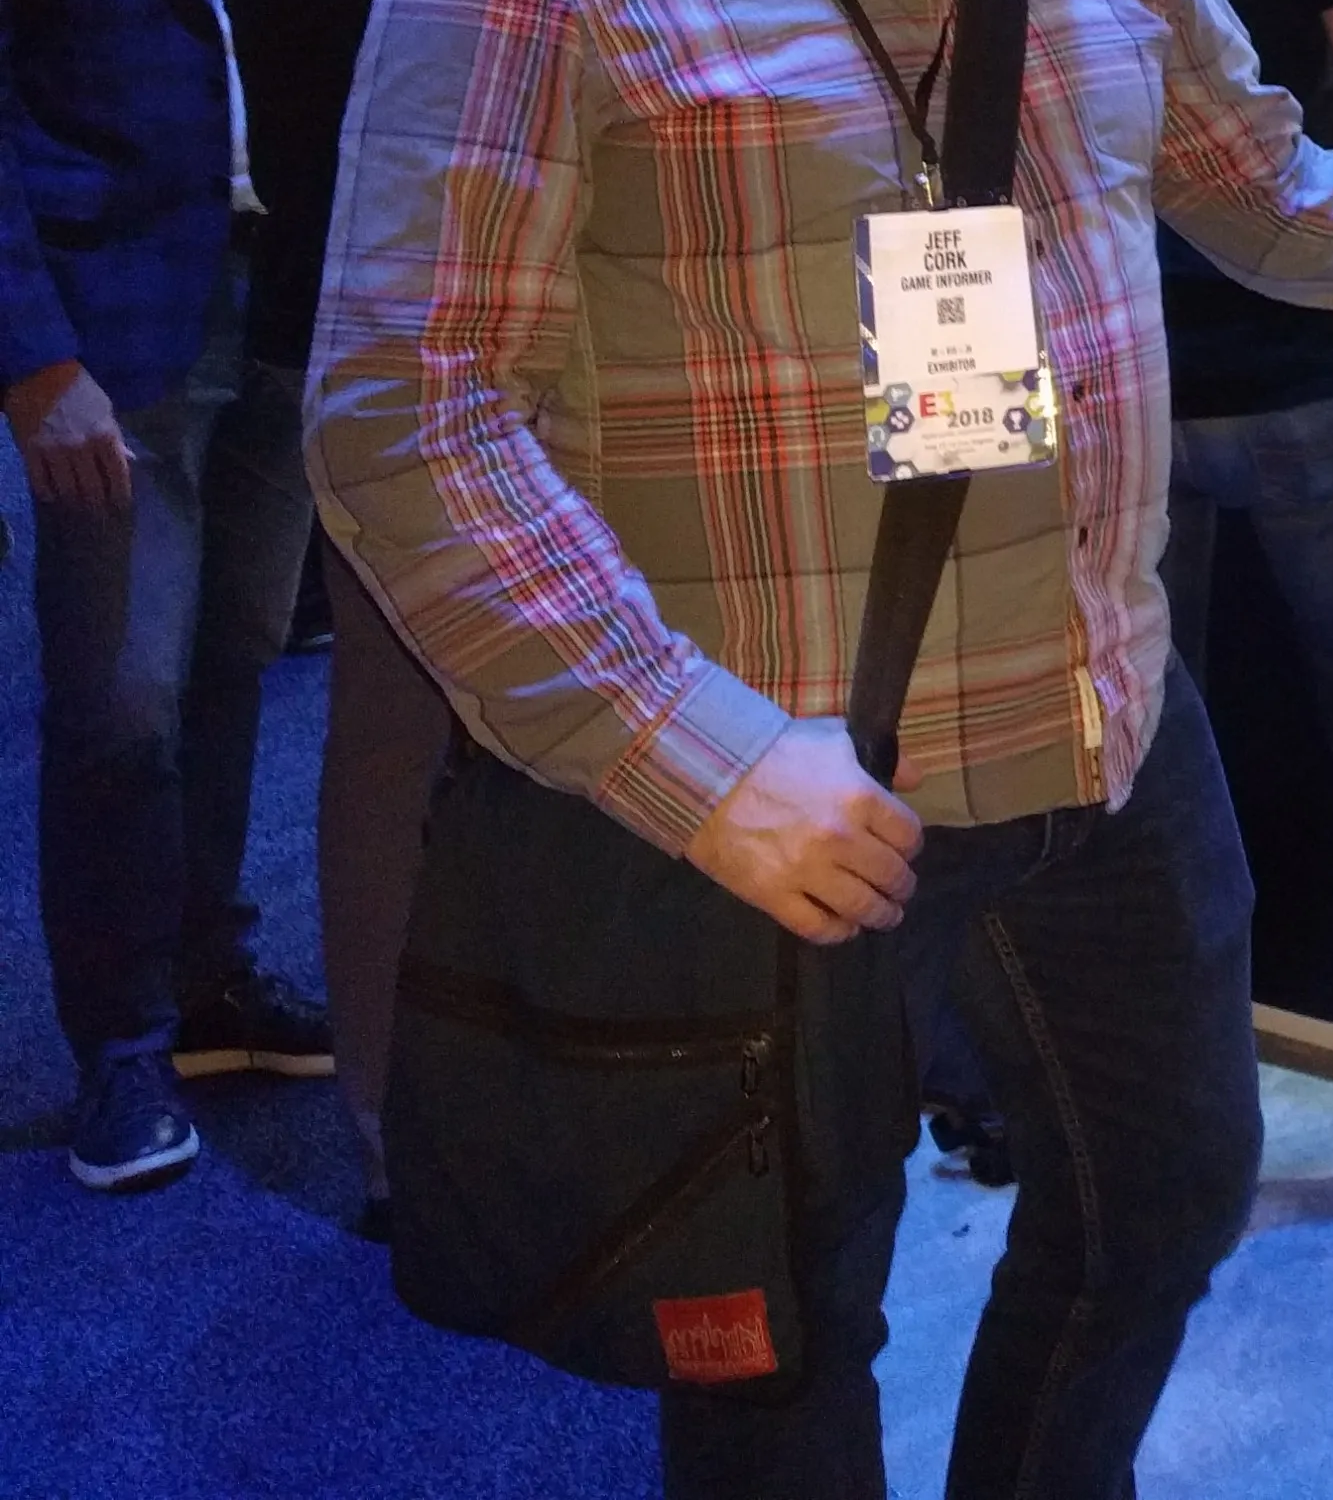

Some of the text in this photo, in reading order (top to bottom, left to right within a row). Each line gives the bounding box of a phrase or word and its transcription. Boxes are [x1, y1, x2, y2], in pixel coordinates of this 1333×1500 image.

[925, 230, 962, 251] JEFF
[924, 251, 968, 272] CORK
[901, 271, 993, 292] GAME INFORMER
[927, 358, 976, 375] EXHIBITOR
[947, 407, 994, 428] 2018
